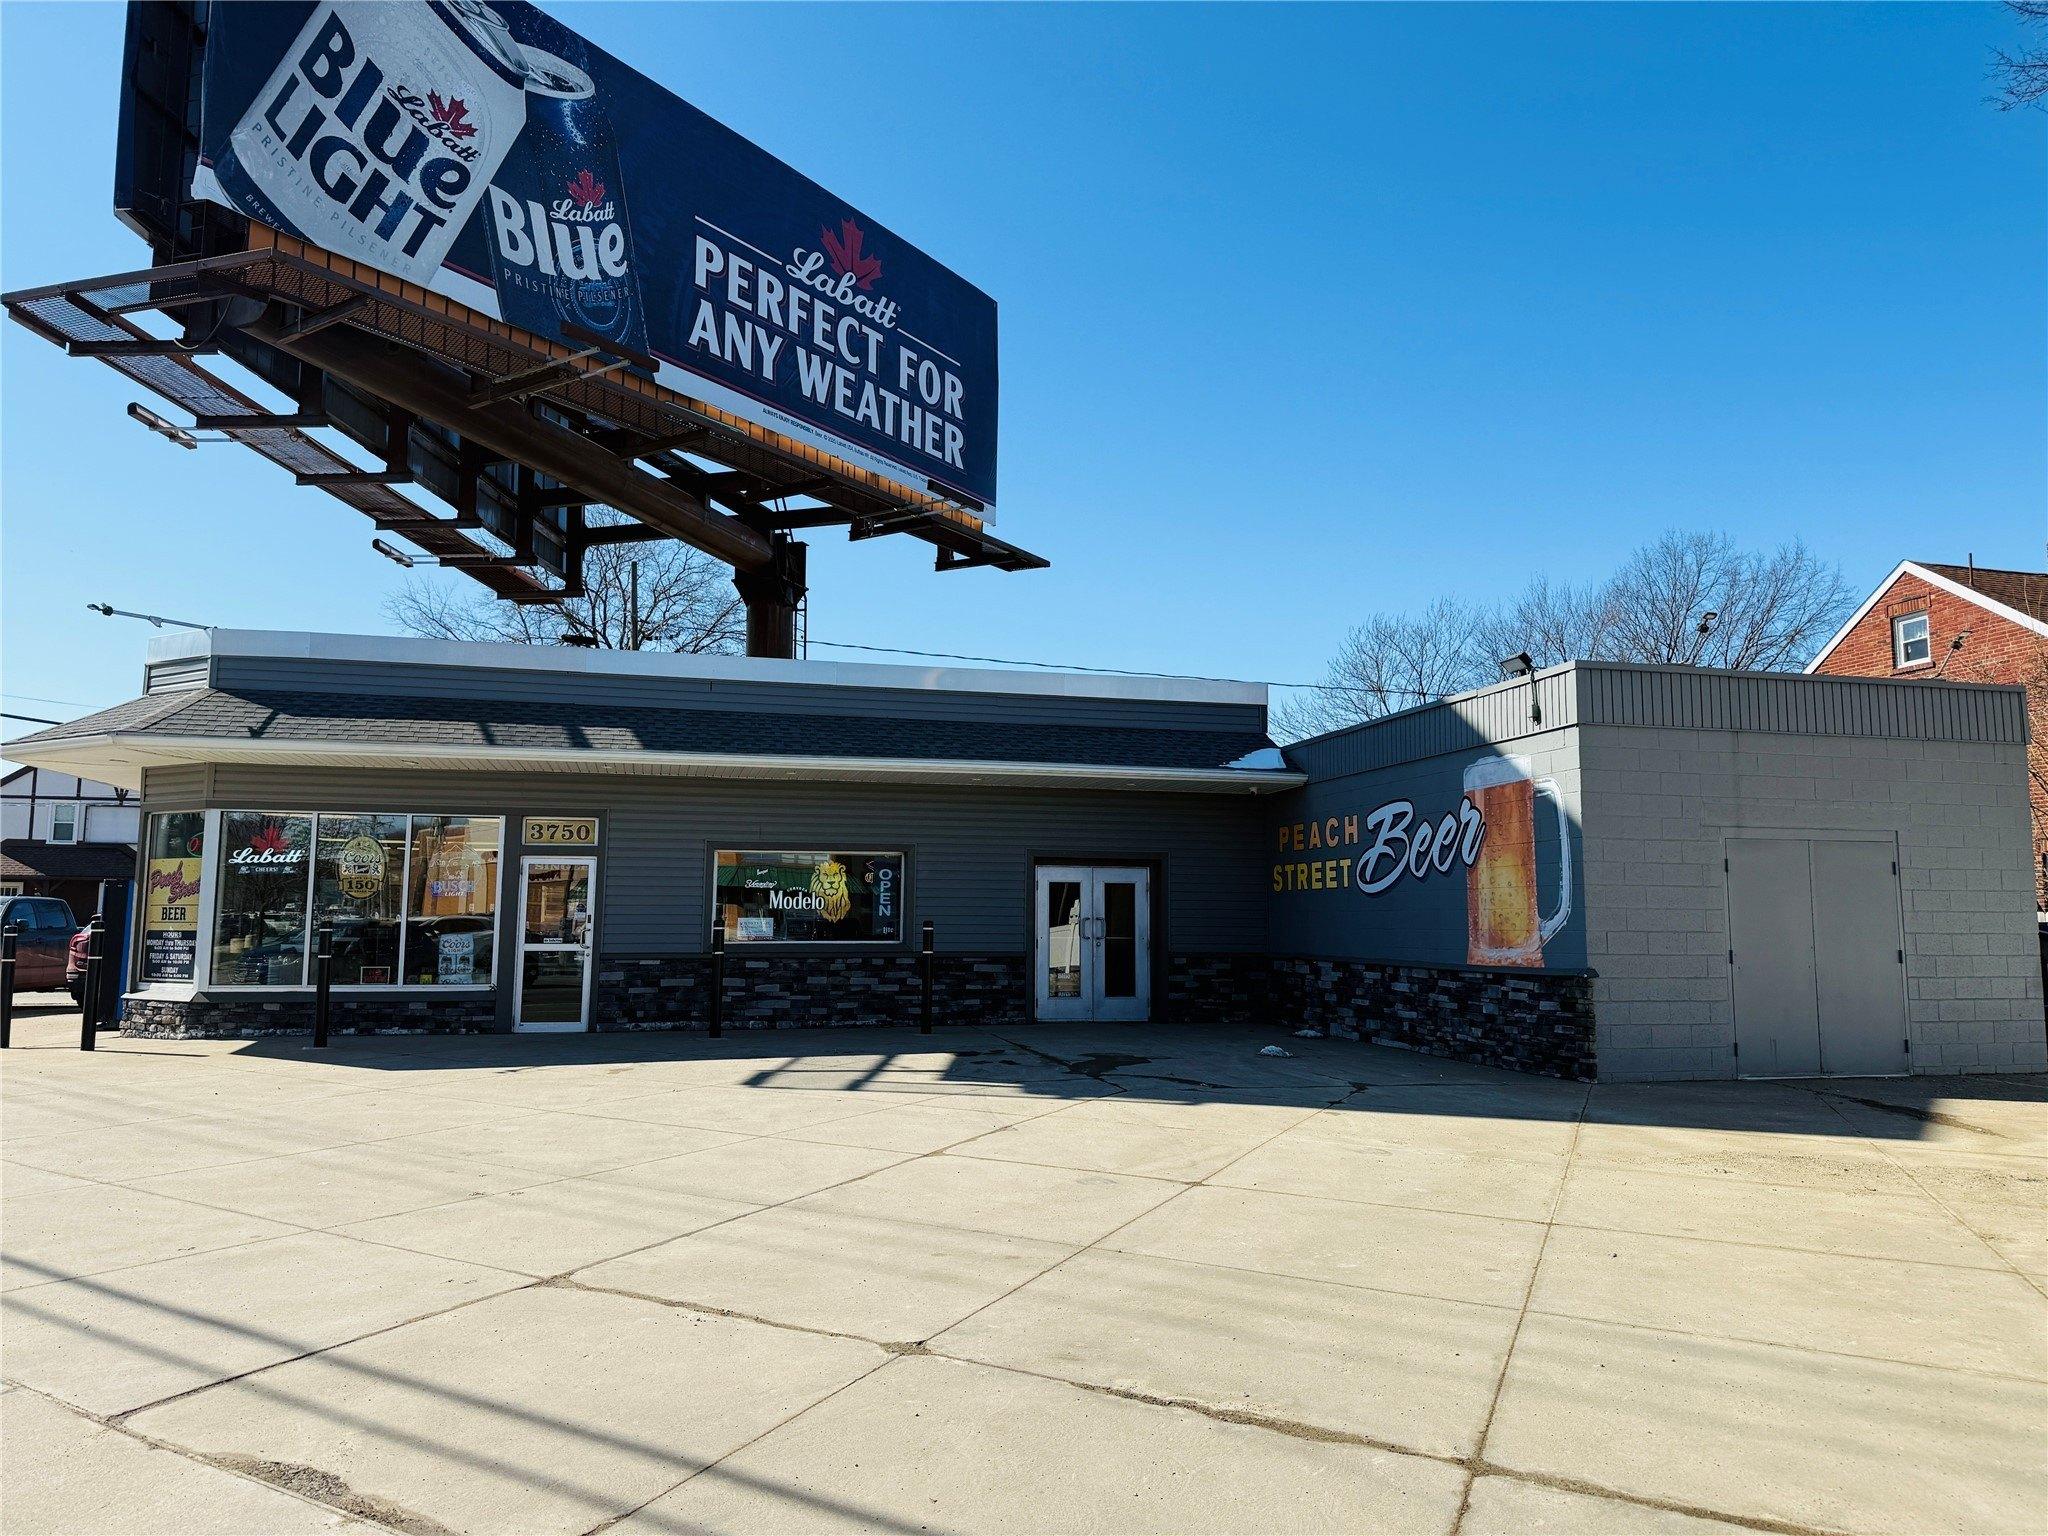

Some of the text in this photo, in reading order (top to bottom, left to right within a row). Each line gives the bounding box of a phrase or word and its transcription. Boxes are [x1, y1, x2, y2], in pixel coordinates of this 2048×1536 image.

[298, 9, 471, 213] Blue
[387, 85, 481, 163] Labatt
[264, 72, 447, 259] LIGHT
[251, 122, 412, 274] PRISTINE PILSENER
[549, 199, 615, 221] Labatt
[488, 185, 627, 279] Blue
[504, 267, 630, 302] PRISTINE PILSENER
[786, 247, 896, 329] Labatt
[695, 235, 964, 420] PERFECT FOR
[688, 299, 964, 470] ANY WEATHER
[530, 823, 591, 841] 3750
[1278, 814, 1359, 852] PEACH
[1356, 798, 1485, 894] Beer
[229, 847, 302, 864] Labatt
[343, 850, 381, 863] Coors
[347, 880, 374, 890] 150
[878, 868, 893, 917] OPEN
[1272, 858, 1352, 892] STREET
[161, 907, 186, 921] BEER
[769, 890, 825, 910] Modelo
[162, 931, 182, 939] HOURS
[442, 938, 470, 949] Coors
[161, 966, 179, 974] SUNDAY
